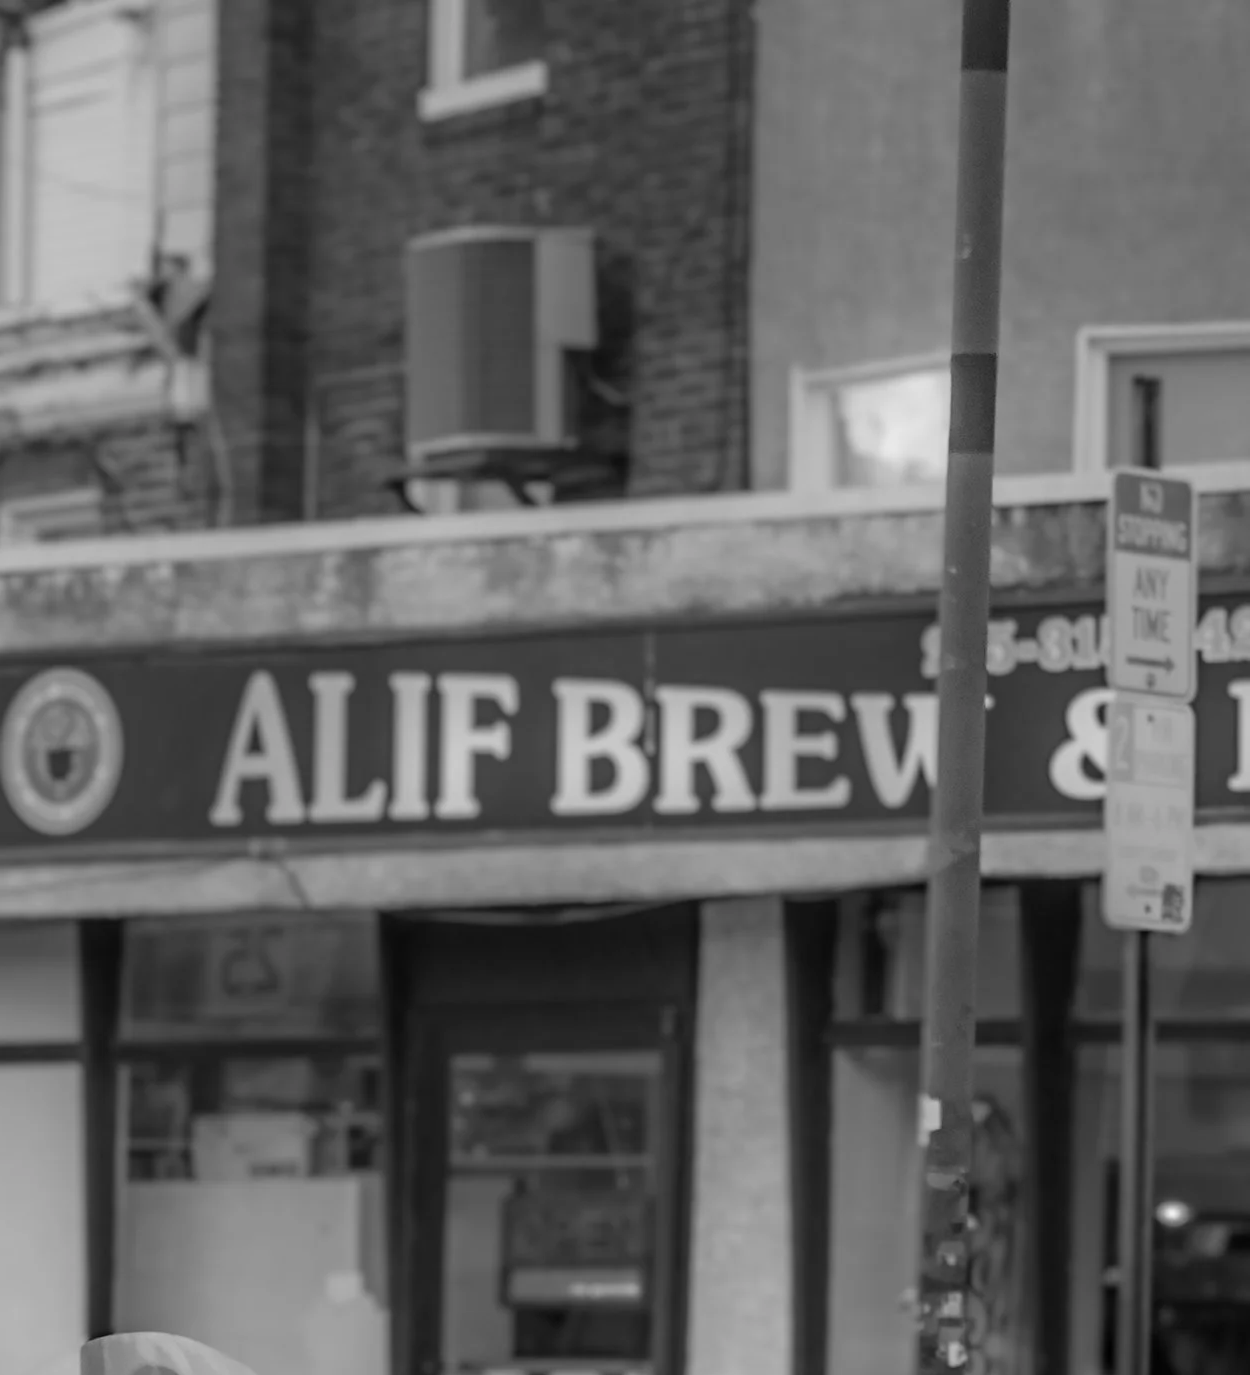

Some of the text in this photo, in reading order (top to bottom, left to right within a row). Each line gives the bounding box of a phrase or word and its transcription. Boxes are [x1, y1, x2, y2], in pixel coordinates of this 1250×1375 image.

[1139, 481, 1164, 514] NO
[1117, 513, 1188, 553] STOPPING
[1133, 566, 1171, 601] ANY
[1132, 605, 1172, 645] TIME
[209, 669, 519, 826] ALIF
[550, 675, 995, 815] BREW
[1049, 687, 1116, 800] &
